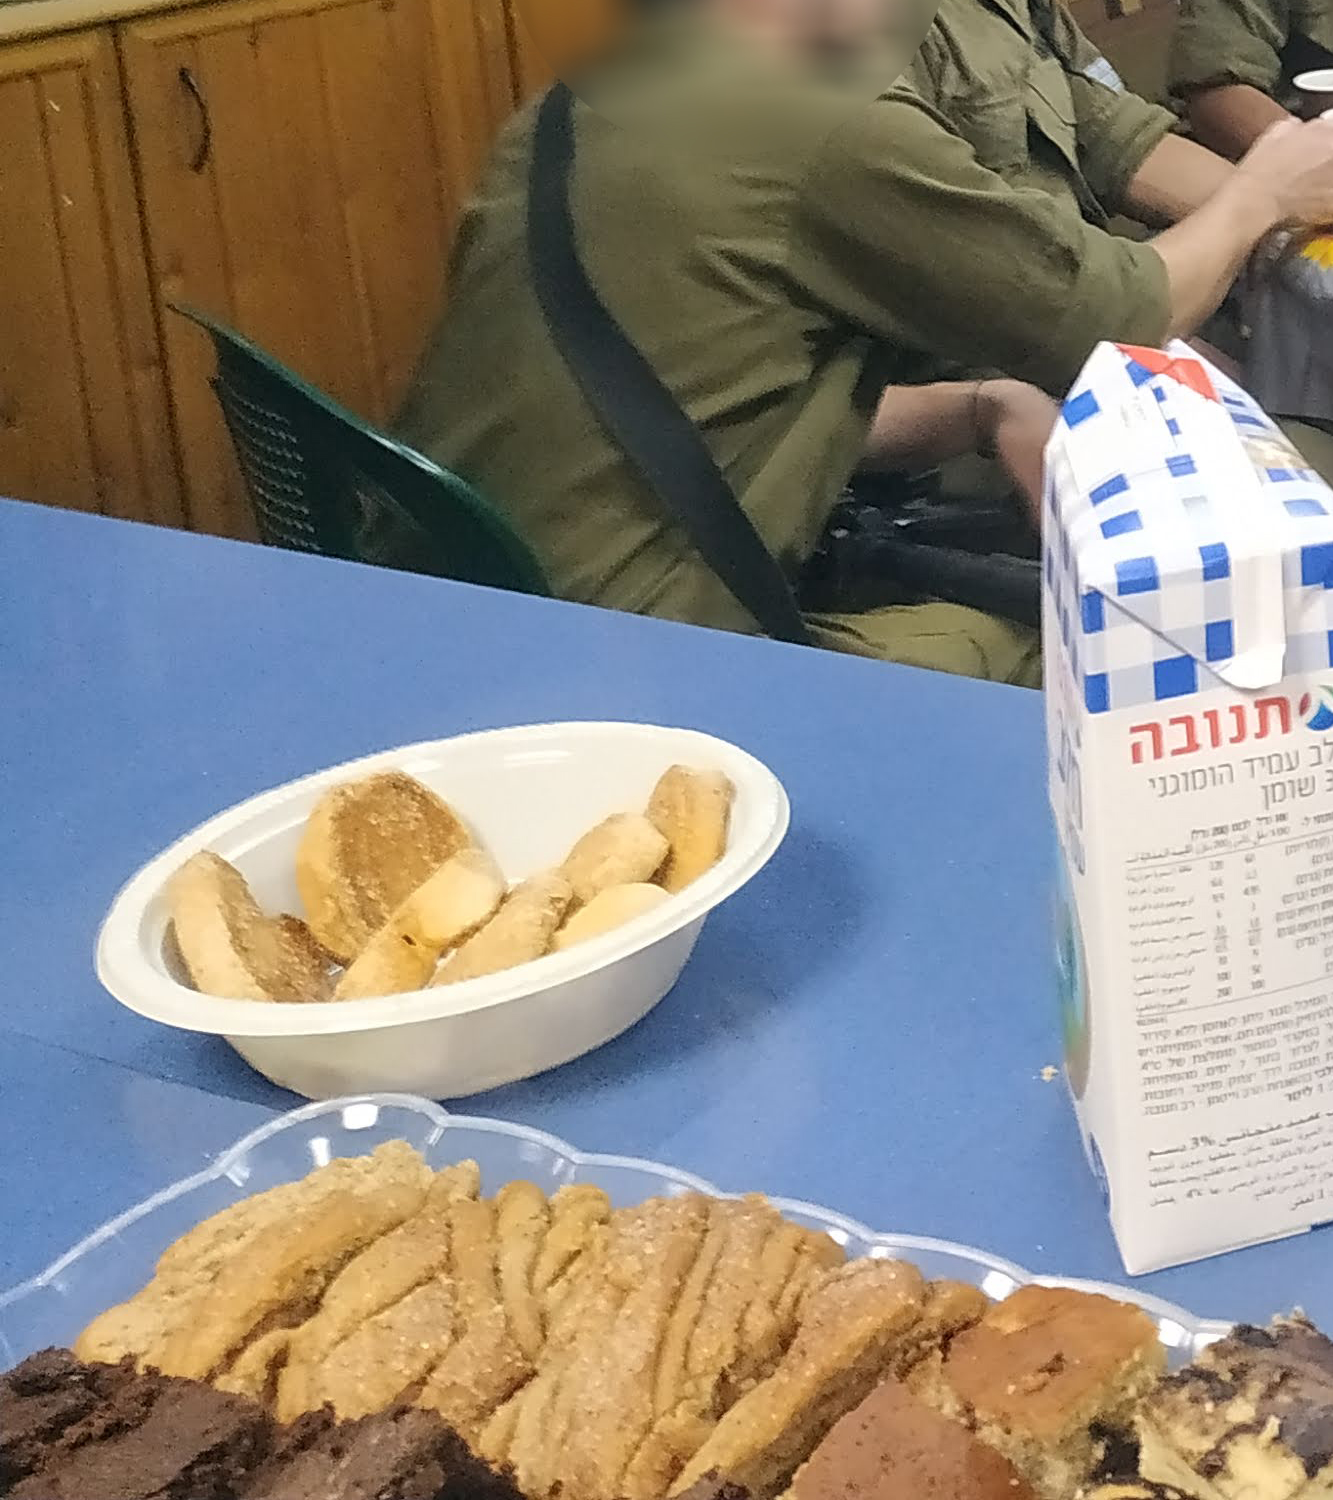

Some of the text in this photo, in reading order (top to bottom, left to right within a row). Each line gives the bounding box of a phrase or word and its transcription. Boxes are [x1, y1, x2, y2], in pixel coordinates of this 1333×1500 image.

[1129, 695, 1292, 765] תנובה
[1149, 763, 1234, 799] הומוגני
[1242, 750, 1300, 779] עמיד
[1263, 777, 1316, 811] שומן
